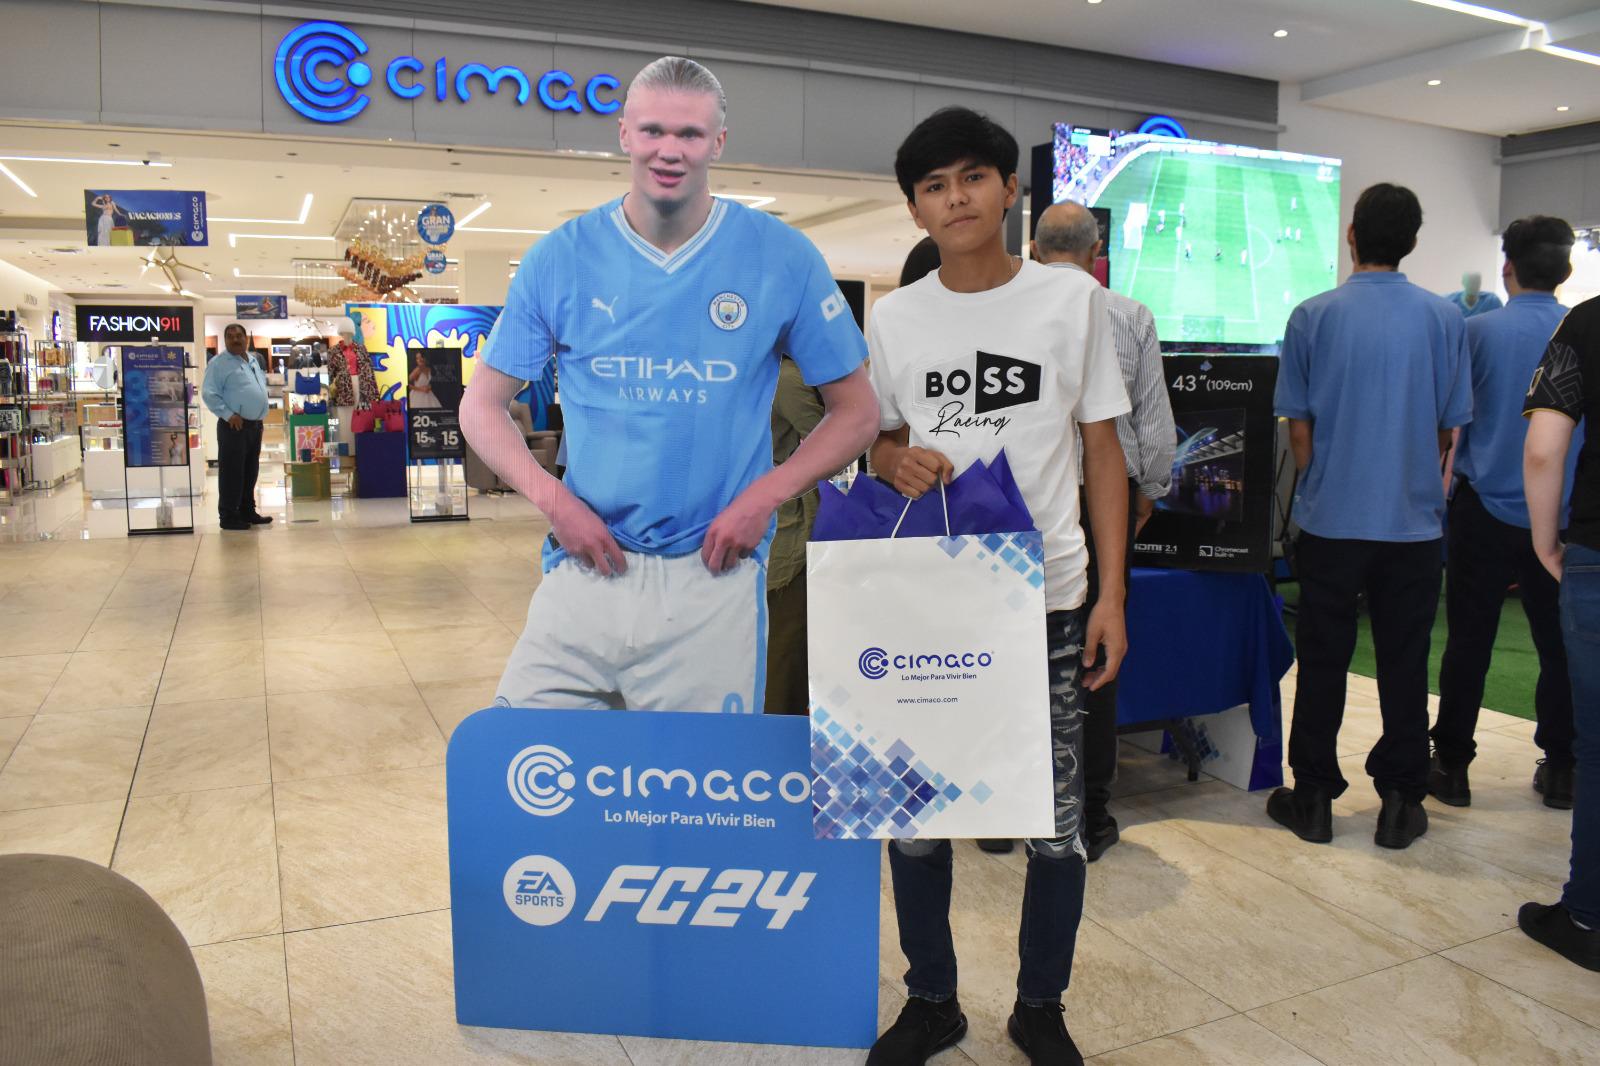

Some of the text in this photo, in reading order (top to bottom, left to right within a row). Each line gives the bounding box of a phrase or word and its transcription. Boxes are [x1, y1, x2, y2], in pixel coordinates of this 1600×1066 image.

[386, 56, 623, 115] cimac
[422, 215, 450, 225] GRAN
[590, 356, 737, 382] ETIHAD
[926, 365, 1025, 398] BOSS
[1207, 379, 1253, 392] (109cm)
[619, 386, 707, 405] AIRWAYS
[412, 415, 438, 428] 20%
[929, 400, 1011, 438] Racing
[415, 431, 436, 444] 15%
[441, 430, 459, 446] 15
[1165, 544, 1178, 552] 2.1
[893, 652, 992, 669] cimaco
[910, 674, 929, 682] Mejor
[896, 696, 958, 704] www.cimaco.com
[586, 764, 811, 804] cimaco
[604, 809, 776, 828] Lo Mejor Para Vivir Bien
[516, 870, 563, 895] EA
[515, 894, 565, 907] SPORTS
